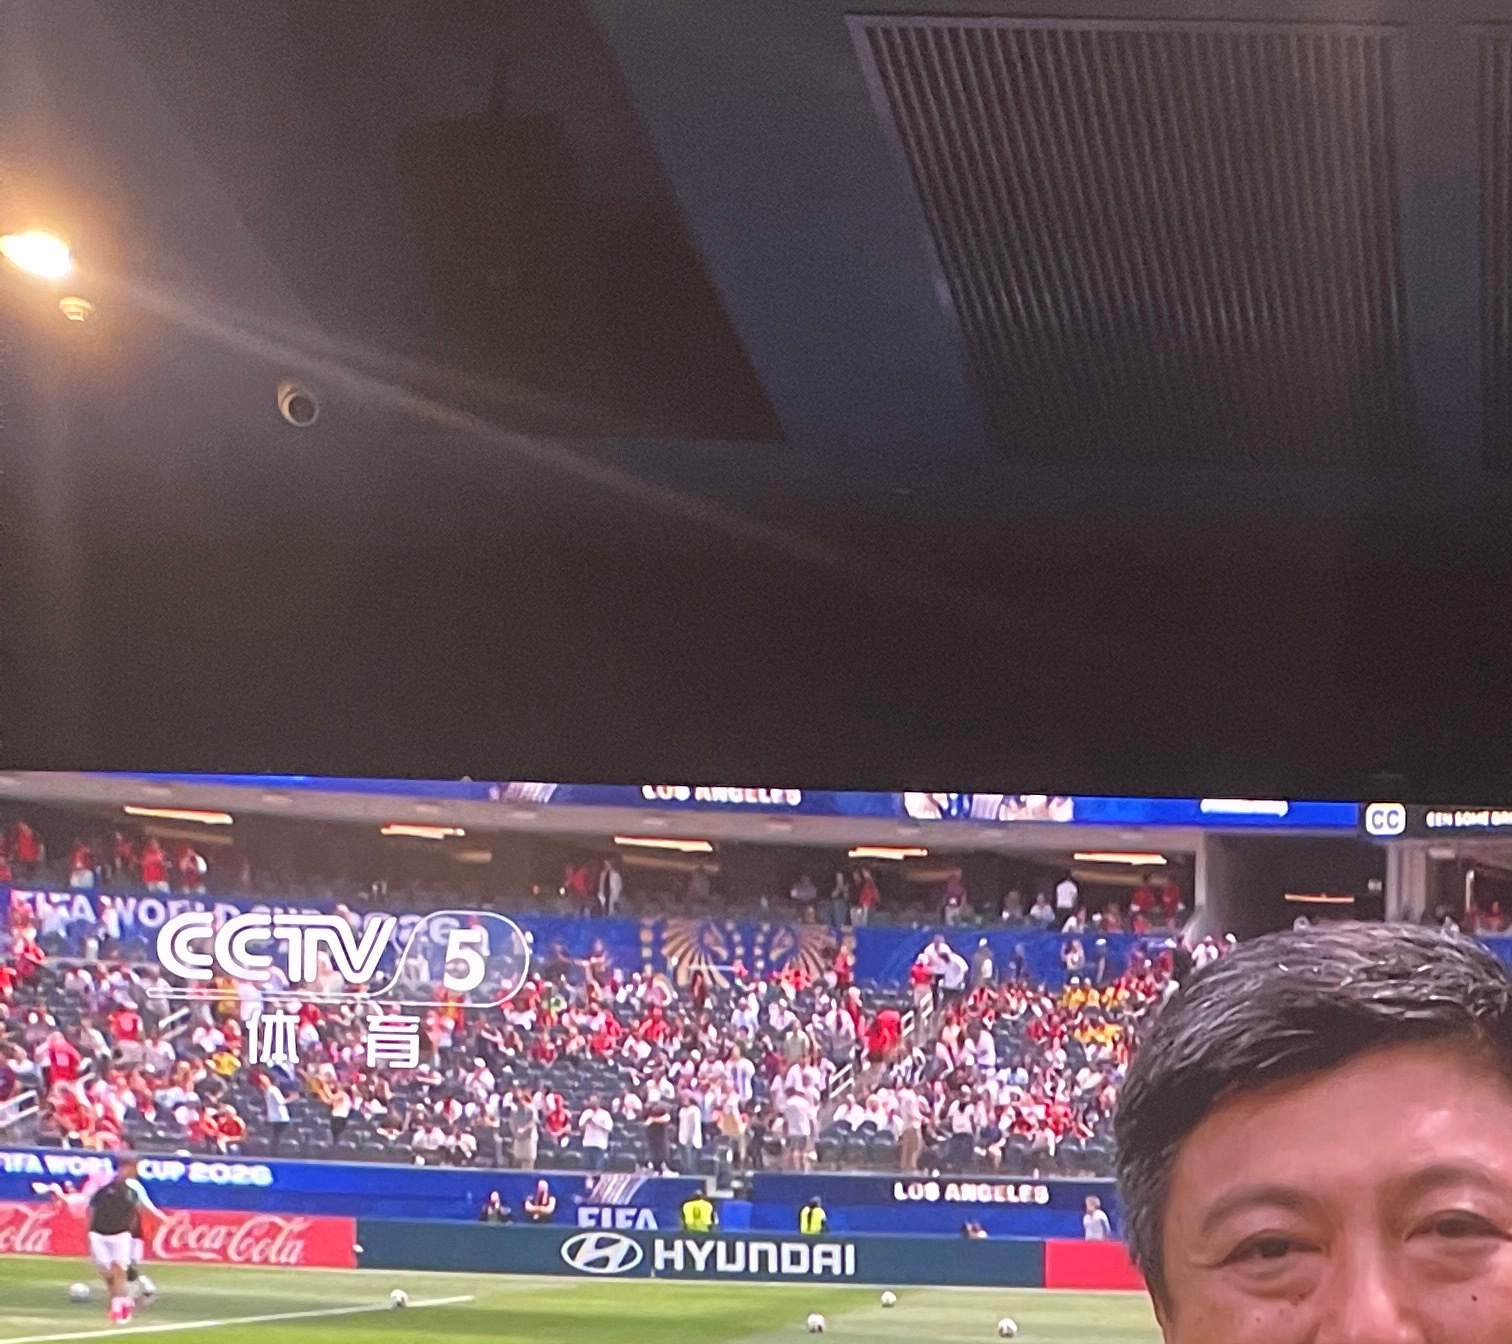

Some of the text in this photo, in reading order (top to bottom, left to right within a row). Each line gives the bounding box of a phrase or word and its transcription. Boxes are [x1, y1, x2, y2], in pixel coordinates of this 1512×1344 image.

[1371, 810, 1400, 829] CC
[156, 911, 487, 992] CCTV 5
[246, 1009, 420, 1069] 体育
[136, 1159, 185, 1181] CUP
[188, 1162, 273, 1186] 2026
[893, 1181, 1050, 1204] LOS ANGELES
[577, 1206, 658, 1230] FIFA
[654, 1238, 855, 1276] HYUNDAI
